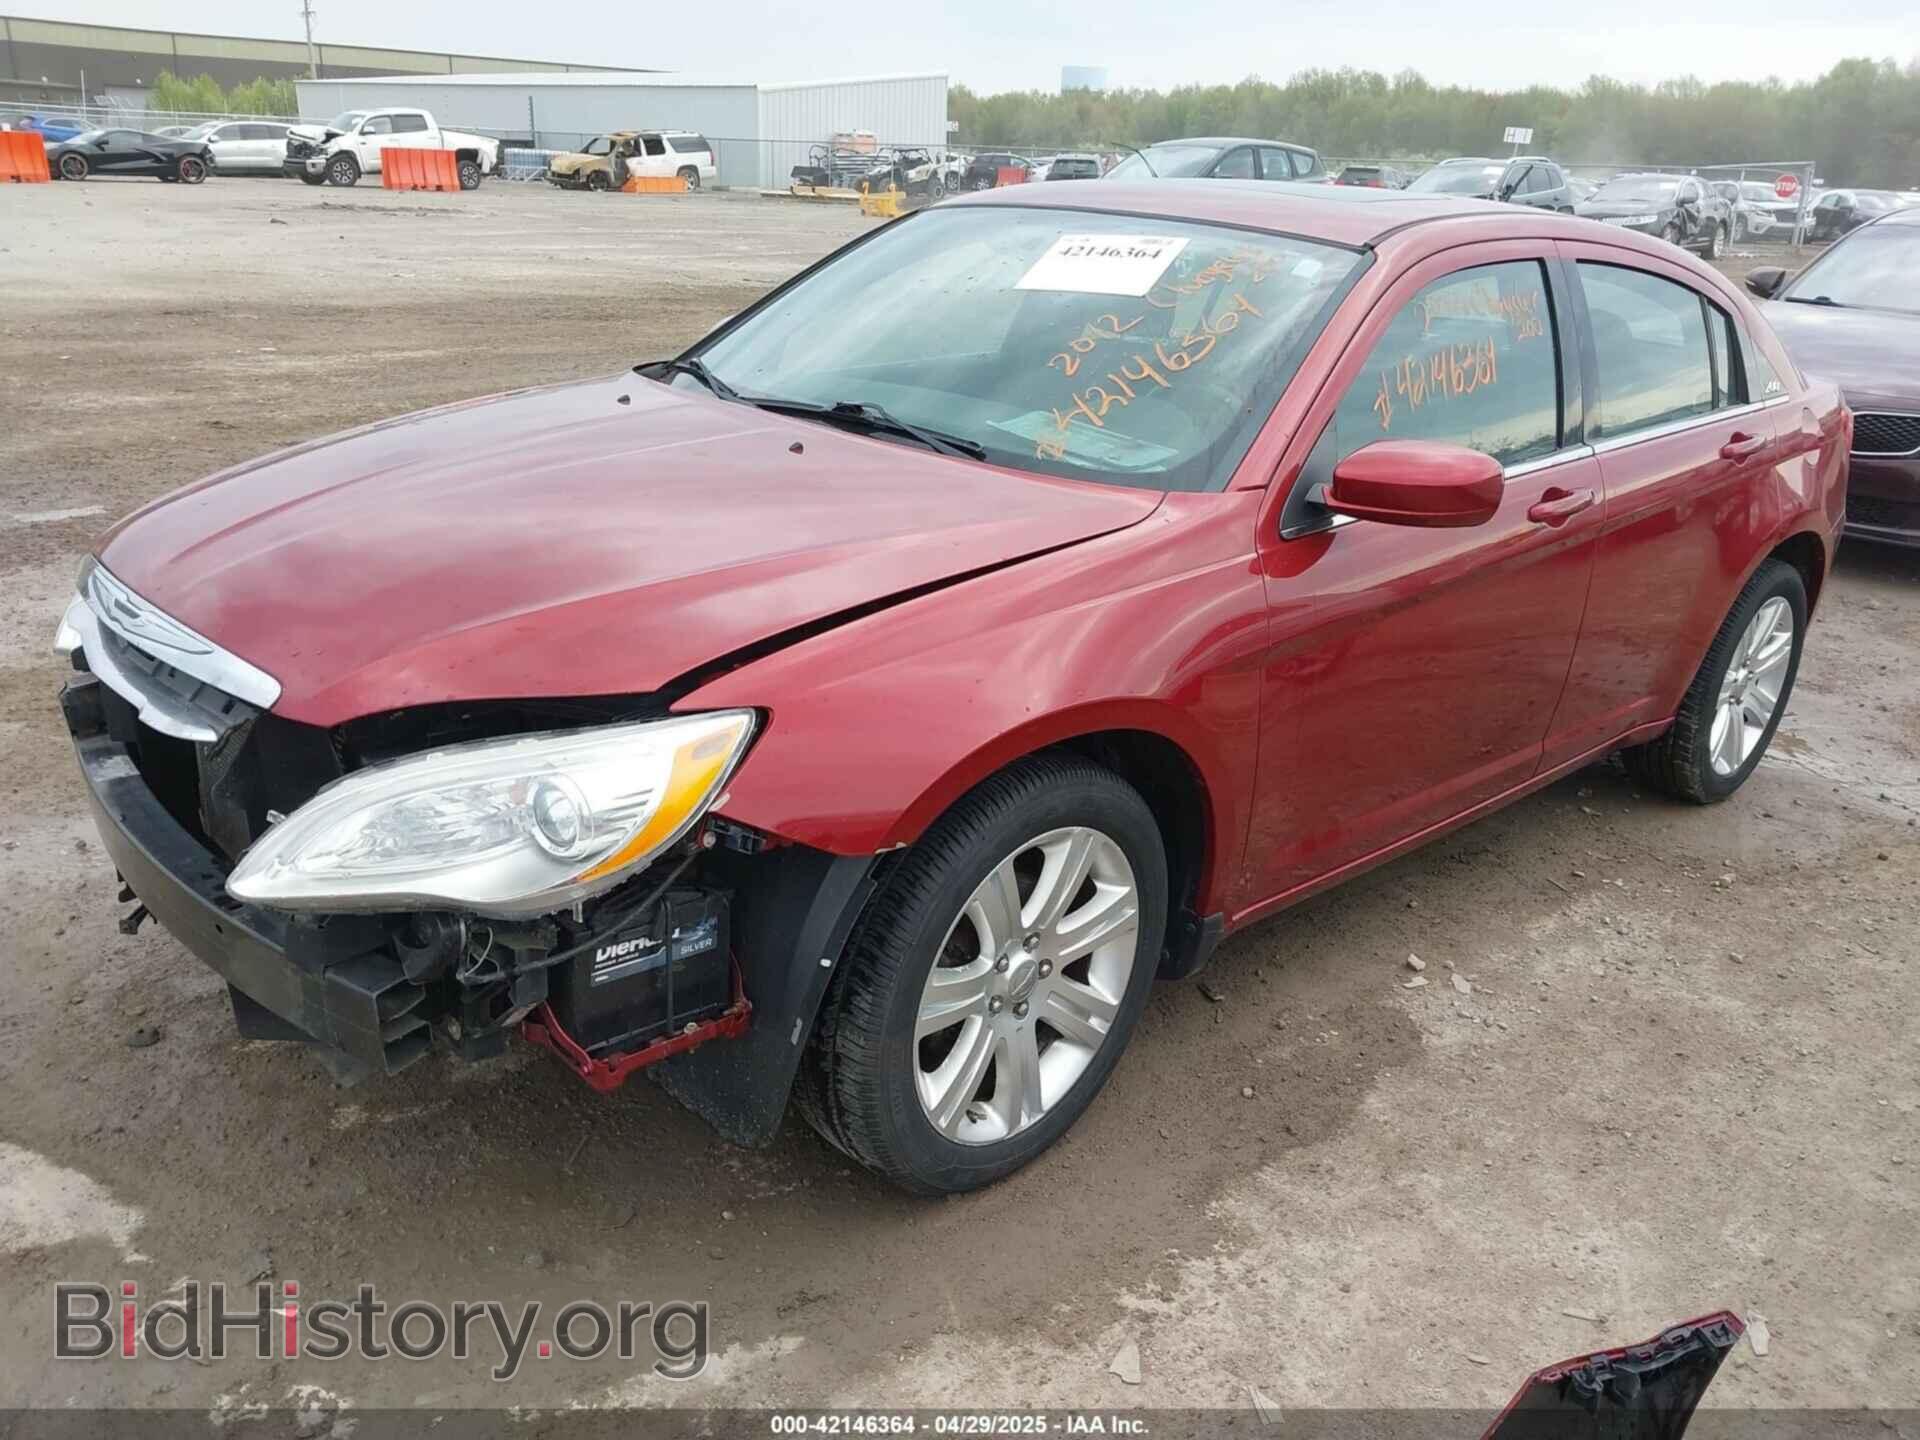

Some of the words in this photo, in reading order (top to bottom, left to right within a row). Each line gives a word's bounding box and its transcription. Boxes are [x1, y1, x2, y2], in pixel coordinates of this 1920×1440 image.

[1776, 182, 1797, 192] STOP
[1059, 245, 1164, 260] 42146364
[680, 938, 713, 956] SILVER
